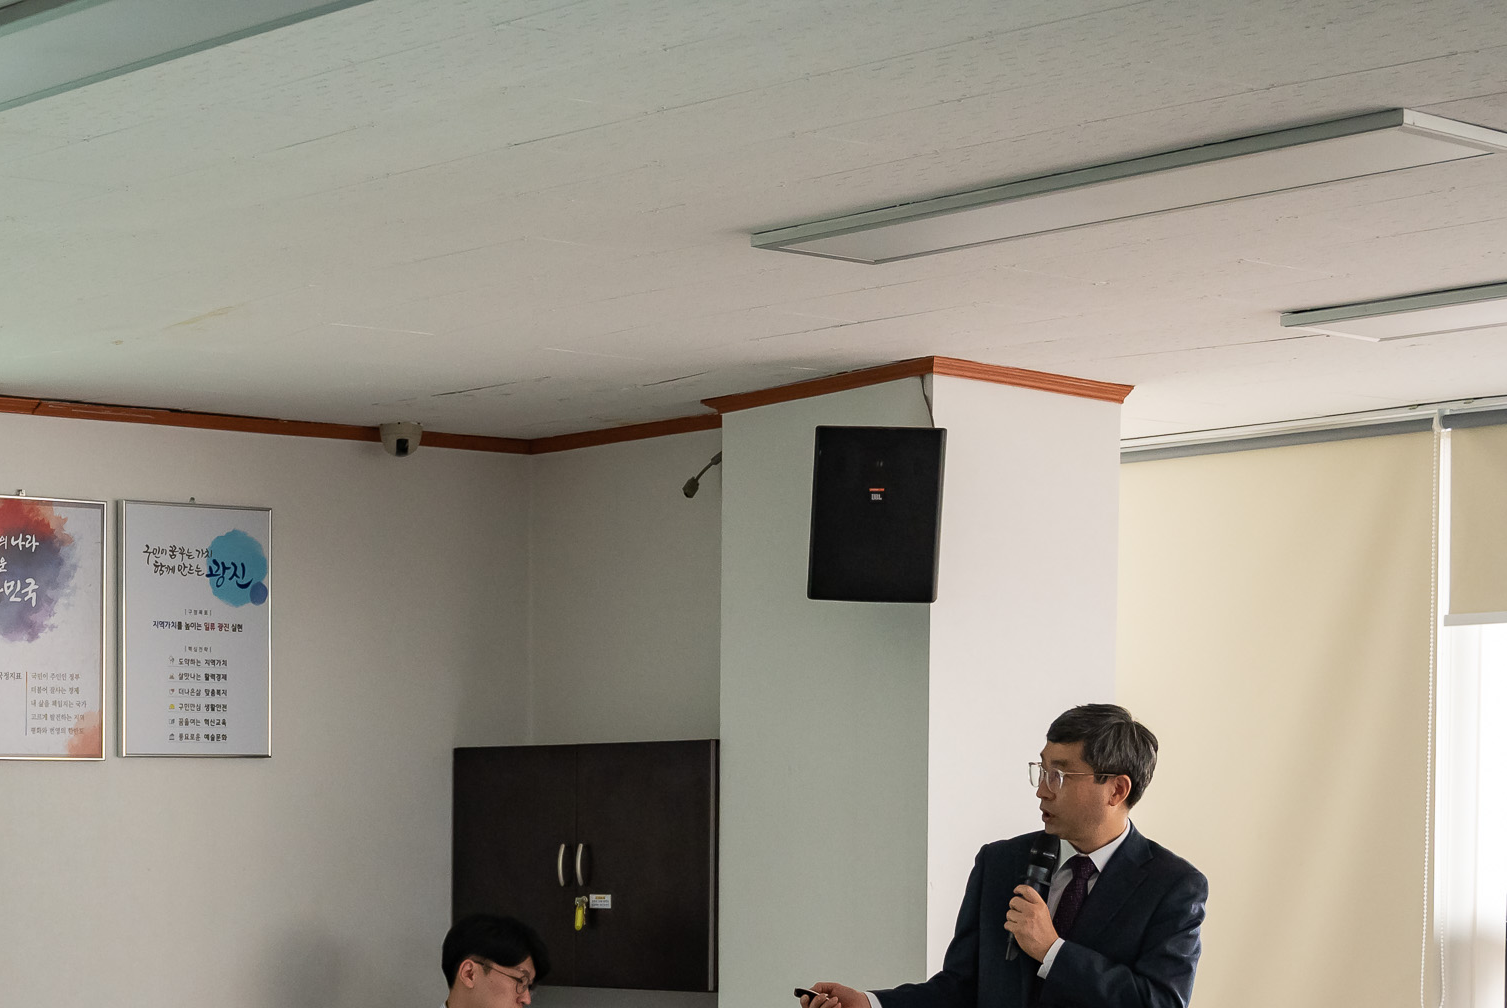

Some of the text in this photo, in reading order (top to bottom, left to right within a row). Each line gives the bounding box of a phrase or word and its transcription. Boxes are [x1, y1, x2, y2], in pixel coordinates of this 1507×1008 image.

[10, 533, 40, 552] 나라
[153, 561, 175, 576] 함께
[205, 558, 253, 589] 광진
[153, 621, 182, 630] 지역가치를
